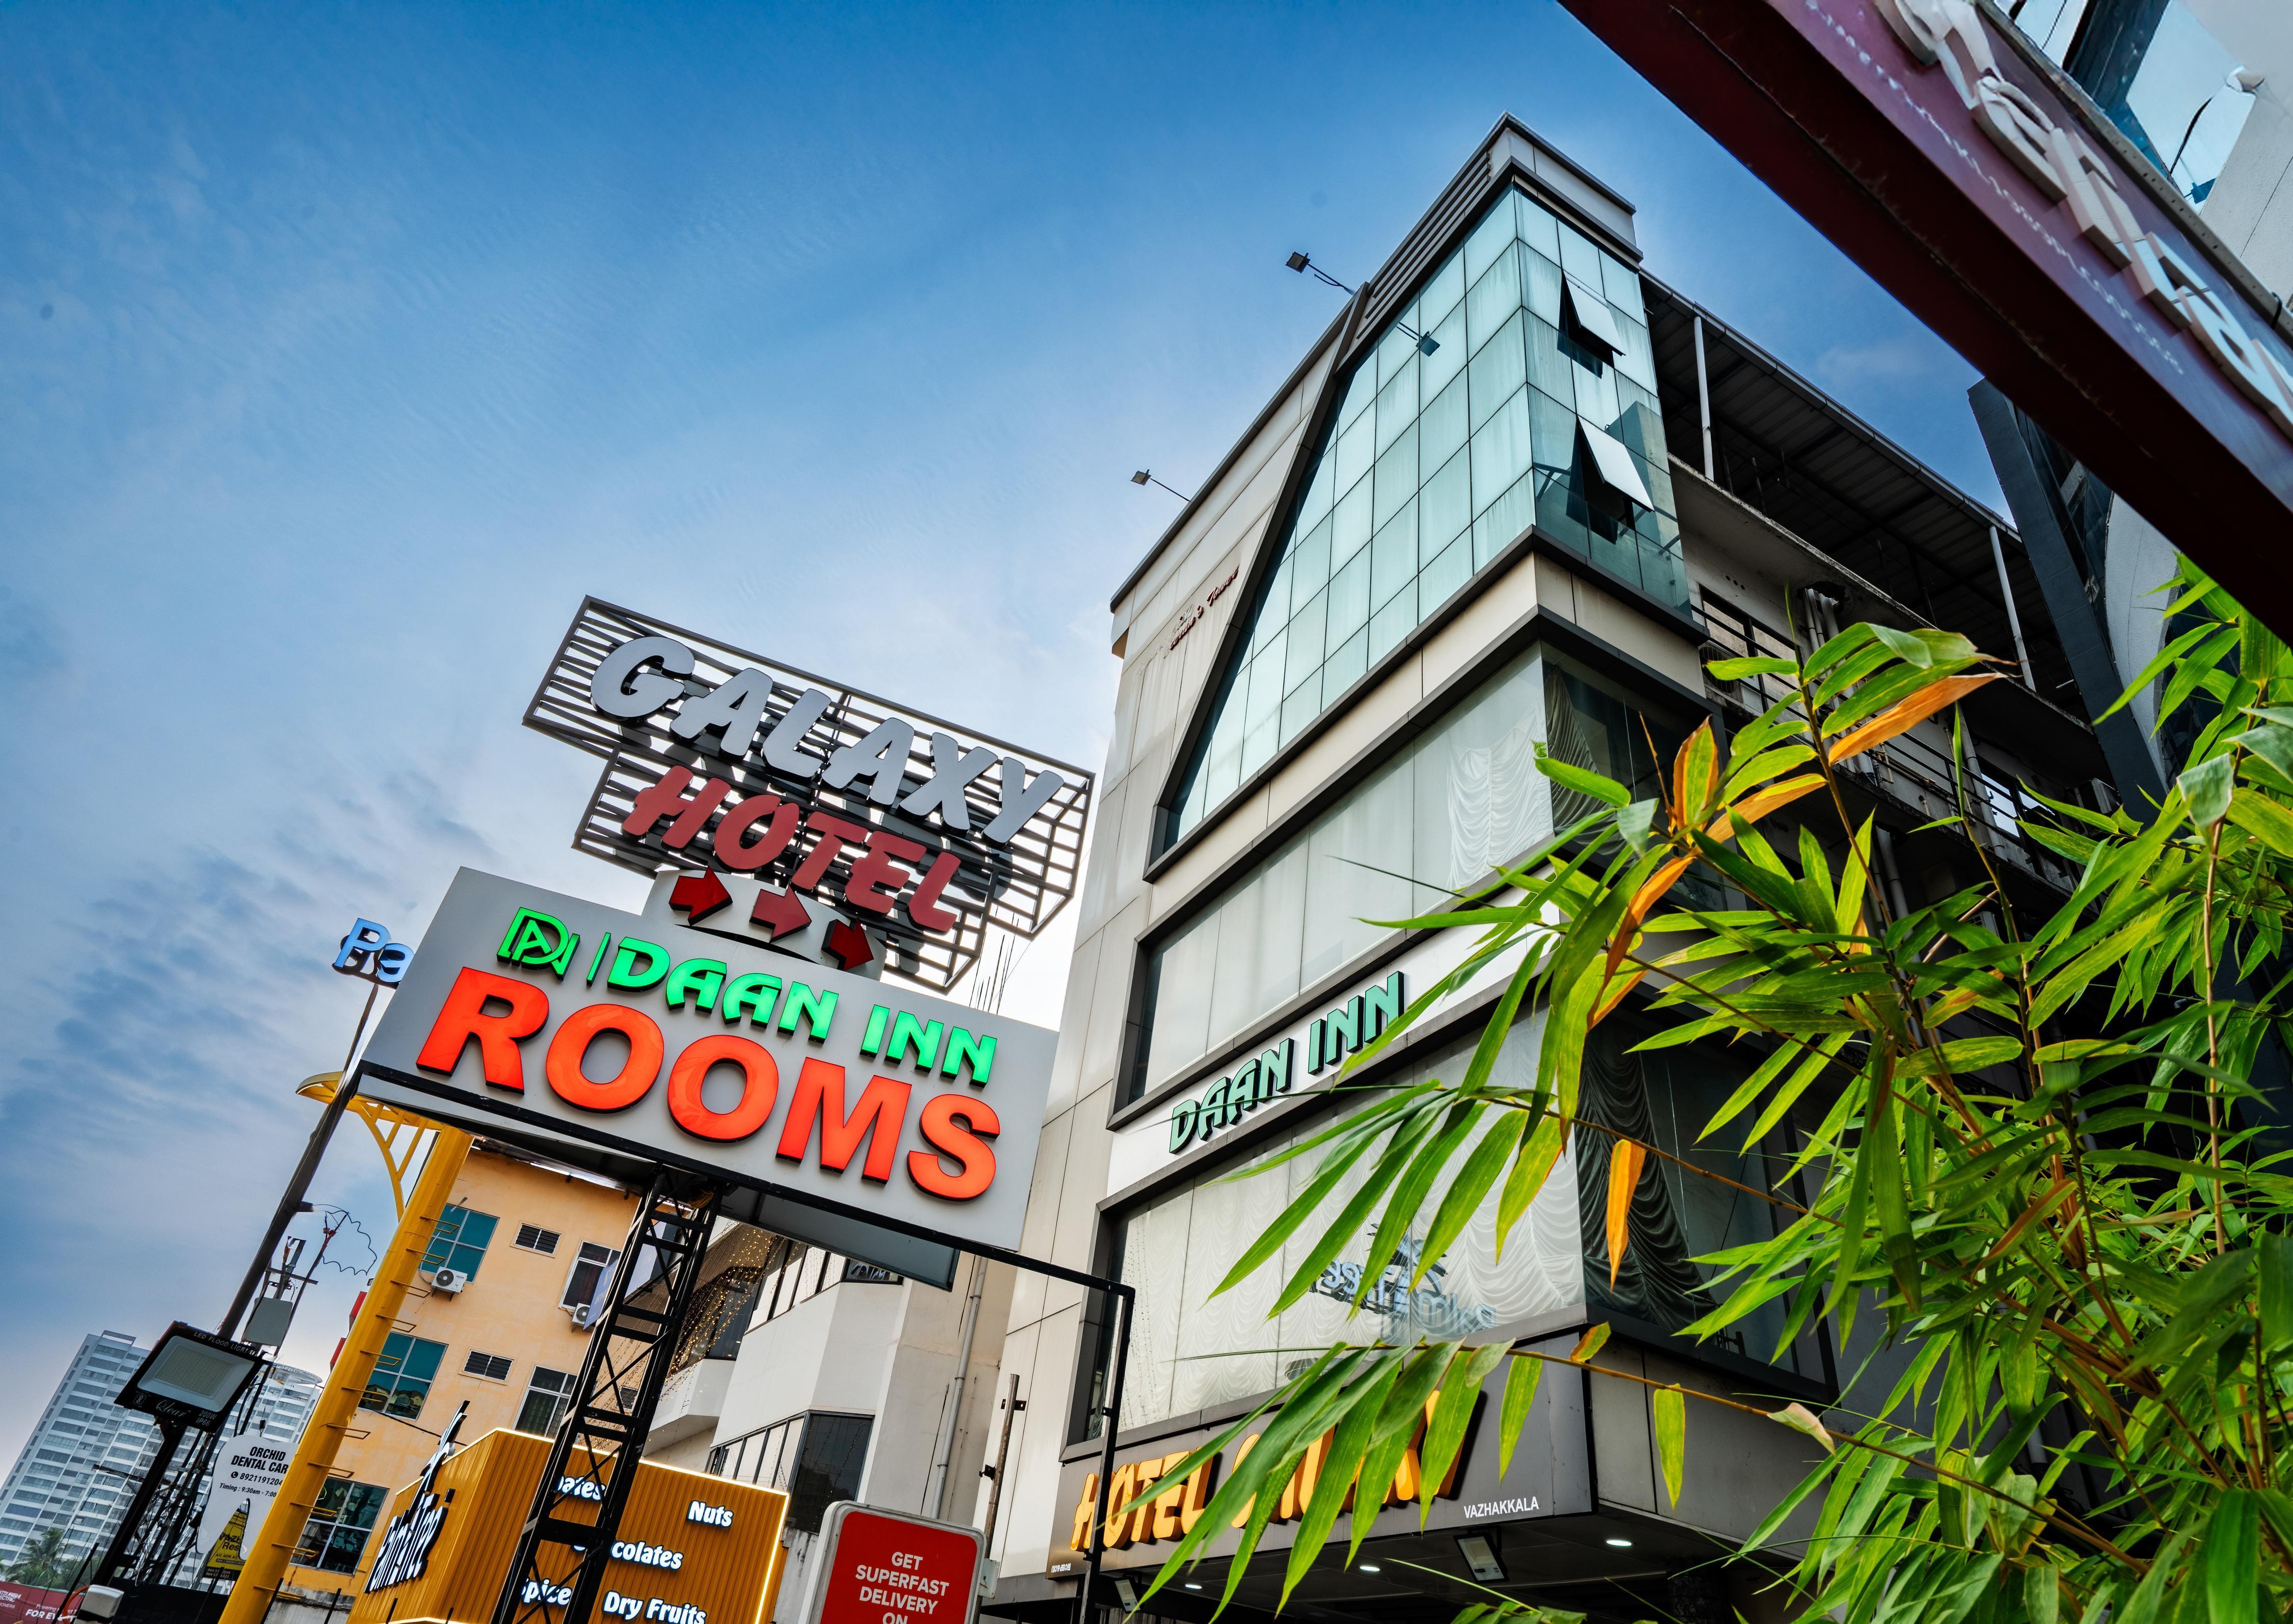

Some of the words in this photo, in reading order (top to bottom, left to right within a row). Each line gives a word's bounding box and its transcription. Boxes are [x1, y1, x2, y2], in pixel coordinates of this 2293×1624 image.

[590, 636, 1064, 847] GALAXY
[621, 765, 962, 933] HOTEL
[606, 936, 838, 1043] DAAN
[860, 1004, 998, 1087] INN
[1169, 1038, 1294, 1154] DAAN
[1308, 970, 1405, 1076] INN
[416, 966, 1001, 1201] ROOMS
[194, 1331, 206, 1339] LED
[208, 1336, 229, 1347] FLOOD
[198, 1410, 217, 1420] 200W
[231, 1455, 266, 1471] DENTAL
[268, 1461, 289, 1474] CAR
[249, 1446, 286, 1461] ORCHID
[219, 1483, 237, 1492] Timing
[241, 1486, 260, 1495] 9:30am
[556, 1476, 605, 1501] ates
[687, 1500, 734, 1527] Nuts
[1070, 1446, 1213, 1552] HOTEL
[1463, 1496, 1539, 1519] VAZHAKKALA
[891, 1552, 923, 1571] GET
[856, 1565, 949, 1596] SUPERFAST
[25, 1609, 45, 1618] FOR
[36, 1604, 57, 1612] Powering
[603, 1590, 644, 1620] Dry
[647, 1598, 707, 1624] Fruits
[859, 1586, 939, 1615] DELIVERY
[882, 1612, 908, 1624] ON
